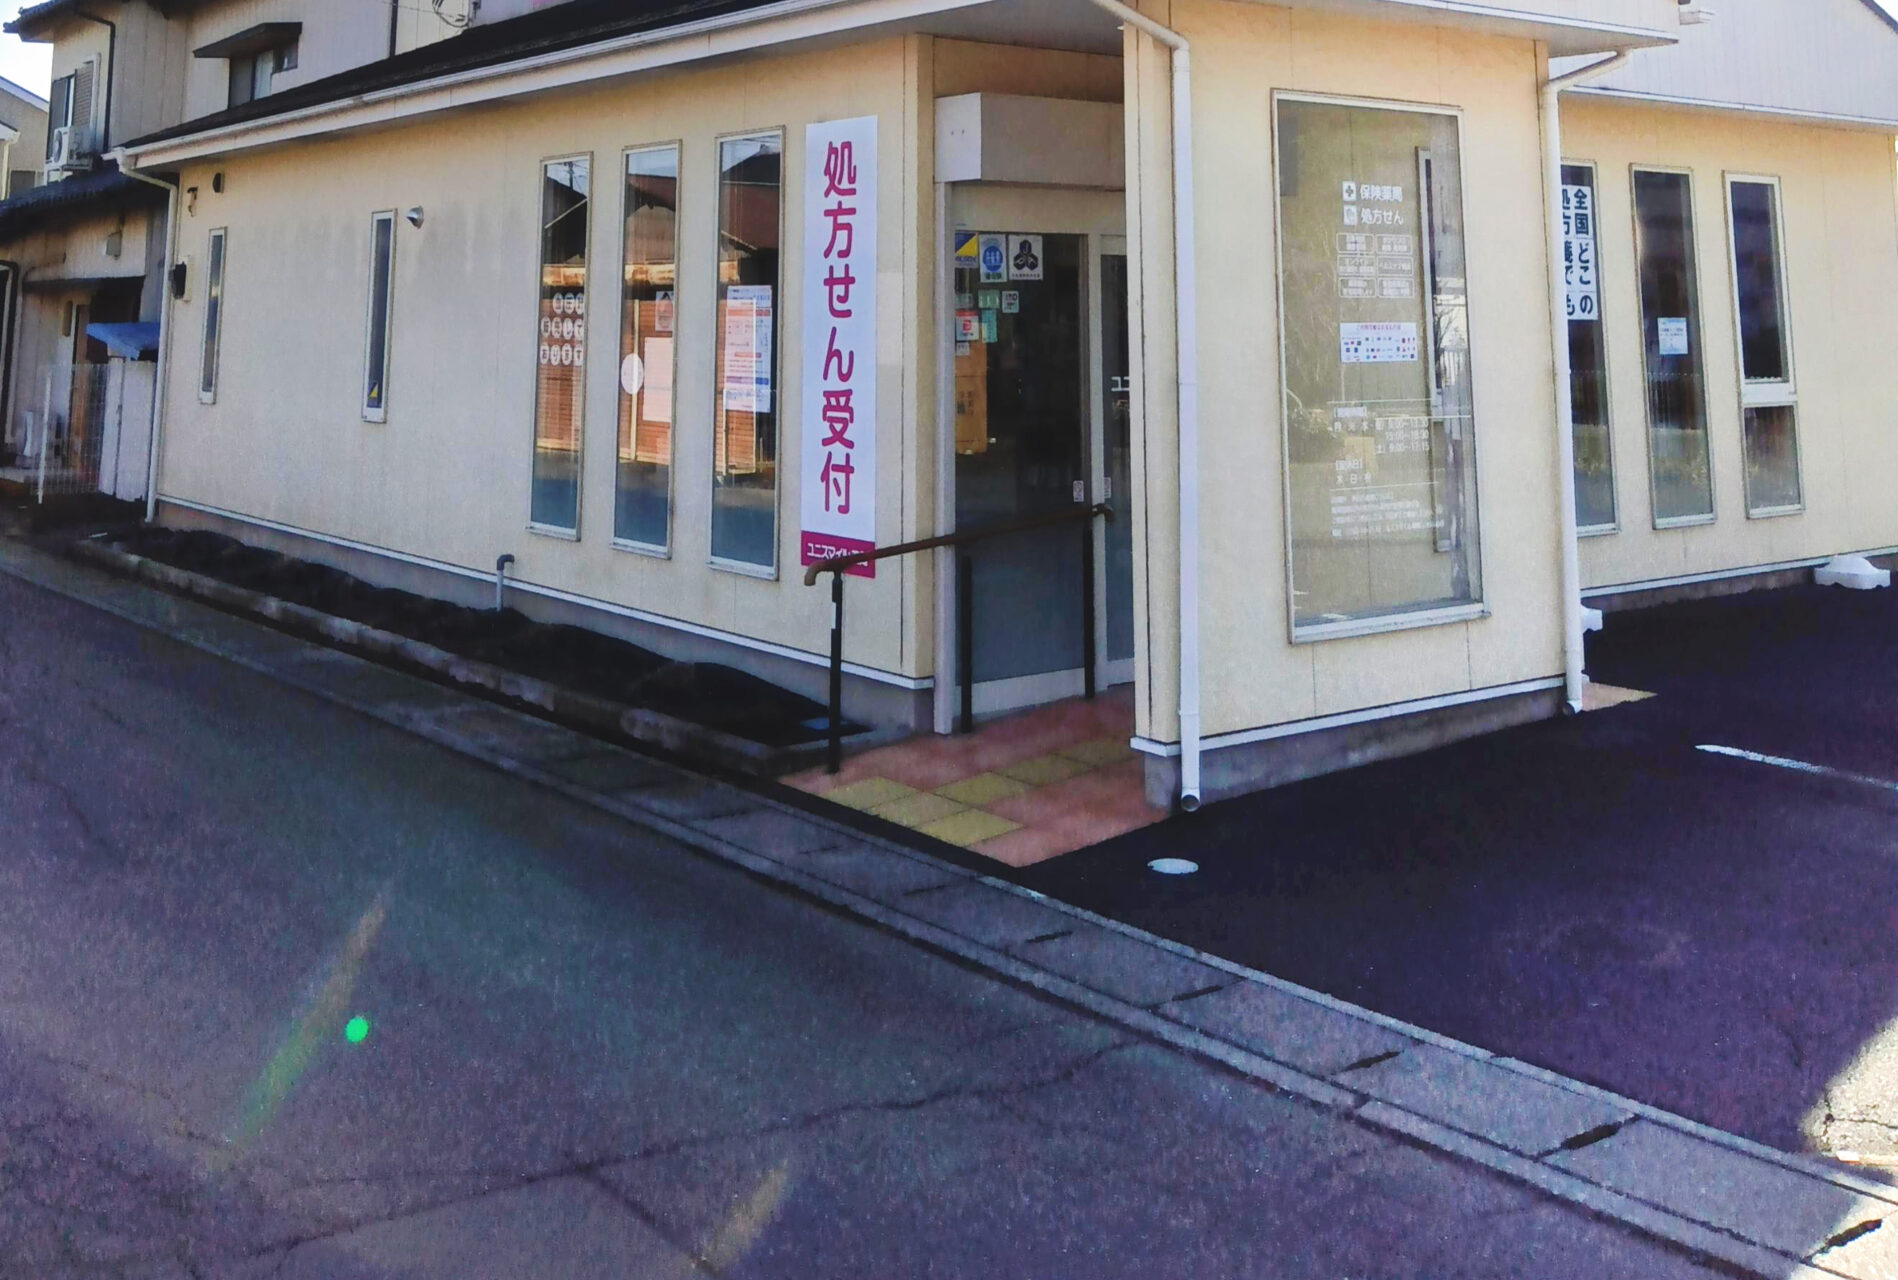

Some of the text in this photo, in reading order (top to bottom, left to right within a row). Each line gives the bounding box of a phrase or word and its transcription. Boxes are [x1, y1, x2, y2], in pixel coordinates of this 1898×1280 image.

[1361, 208, 1405, 225] 処方せん
[1574, 188, 1594, 315] 全国どこの
[820, 140, 857, 514] 処方せん受付
[806, 542, 869, 567] ユニスマイル
